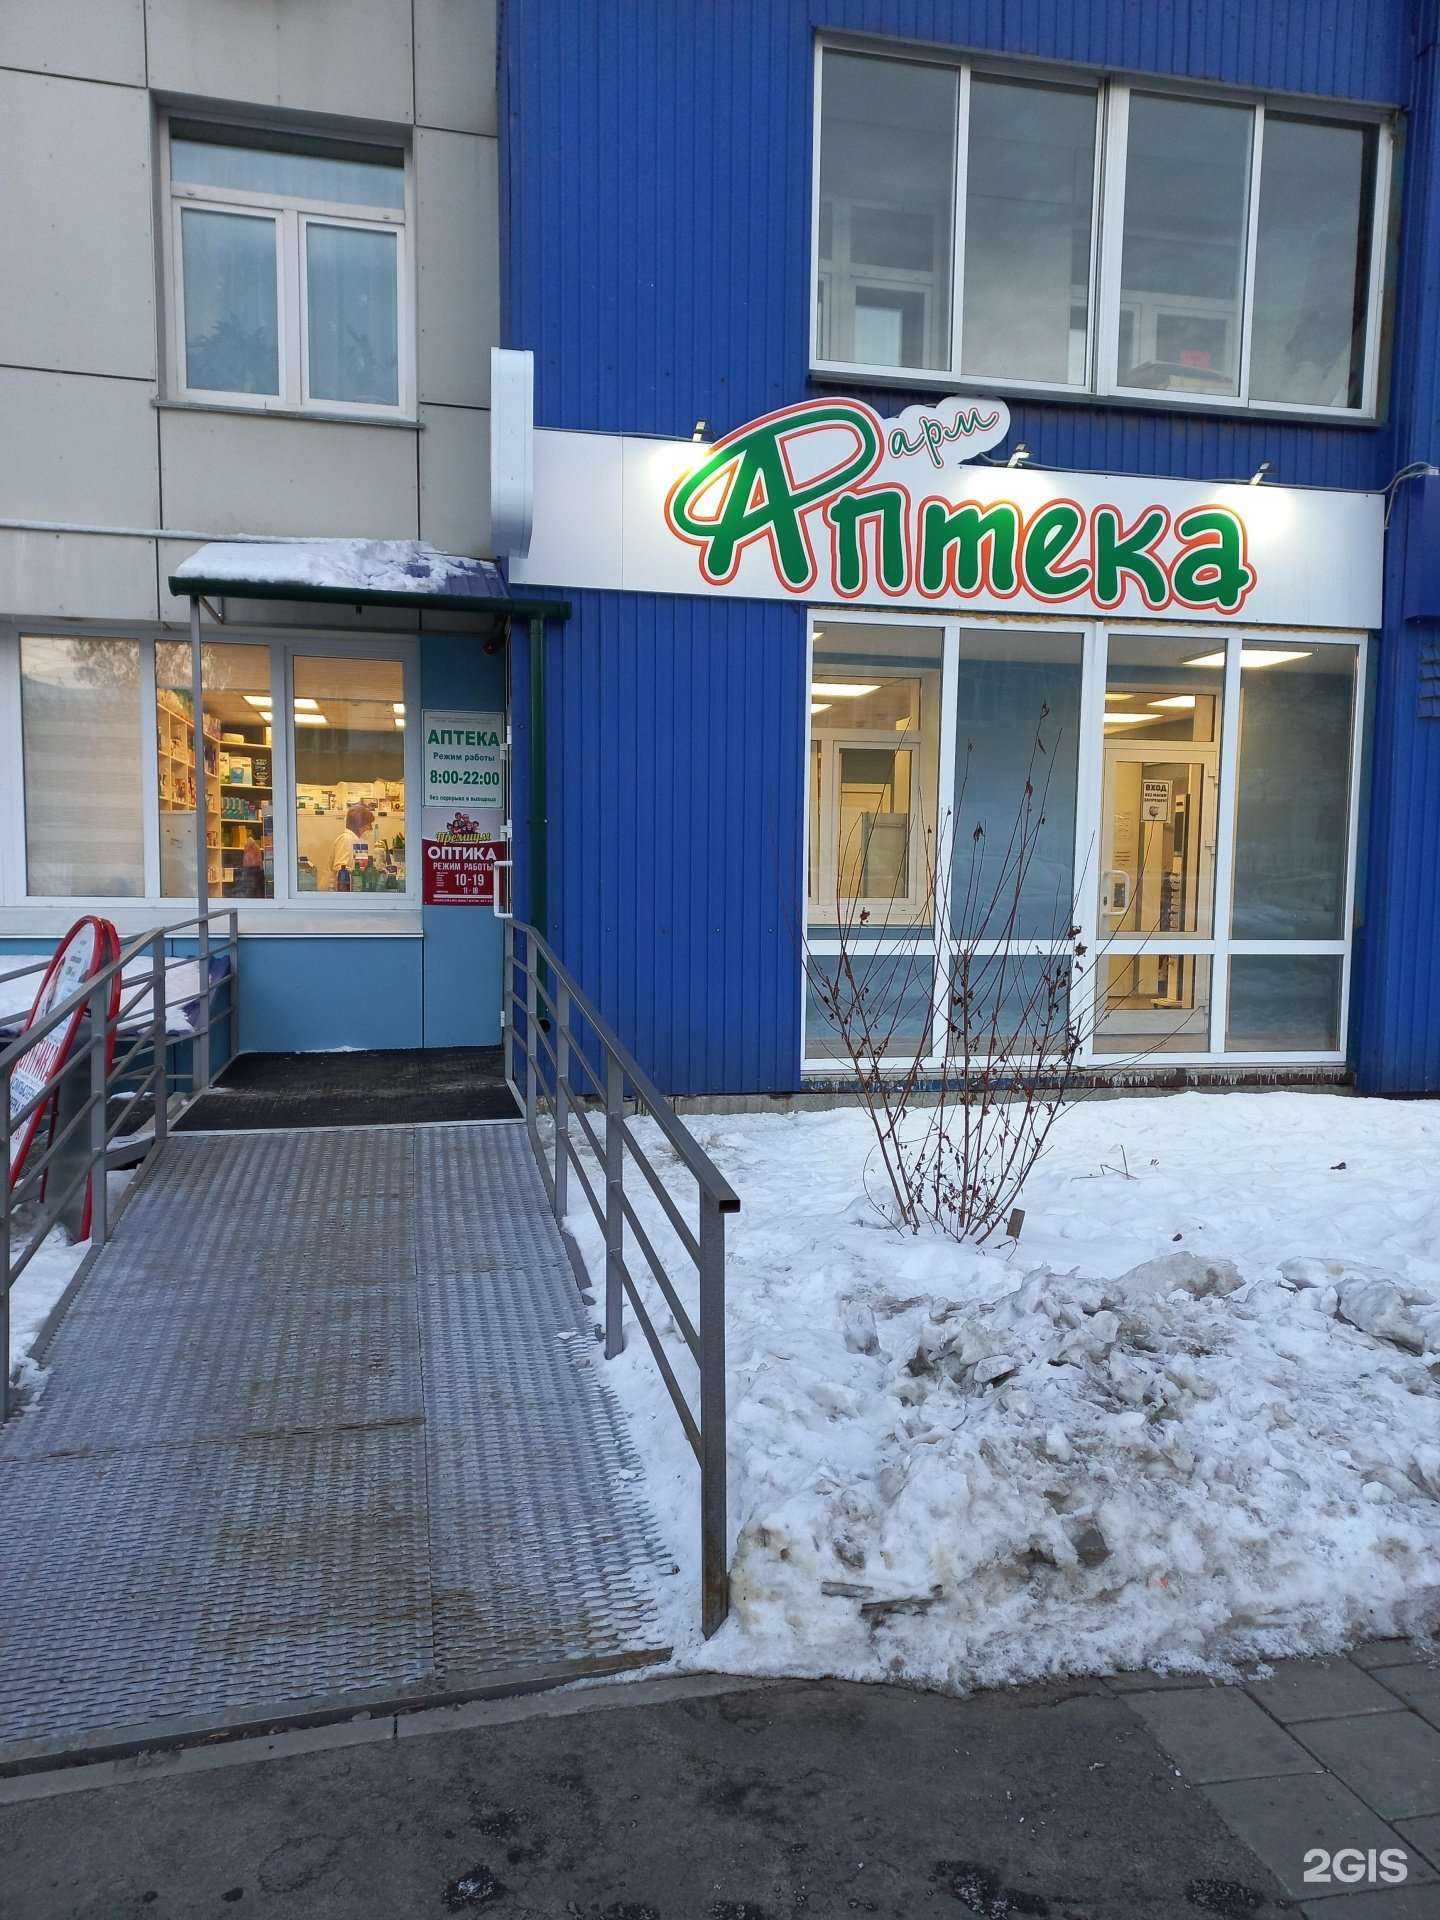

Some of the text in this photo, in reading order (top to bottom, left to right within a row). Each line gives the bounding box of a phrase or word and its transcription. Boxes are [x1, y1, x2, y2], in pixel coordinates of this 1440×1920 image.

[664, 396, 1258, 615] Аптека
[427, 729, 501, 746] АПТЕКА
[433, 751, 496, 762] Режим работы
[429, 769, 500, 785] 8:00-22:00
[1145, 784, 1167, 792] ВХОД
[427, 846, 497, 860] ОПТИКА
[433, 862, 461, 871] РЕЖИМ
[454, 873, 485, 886] 10-19
